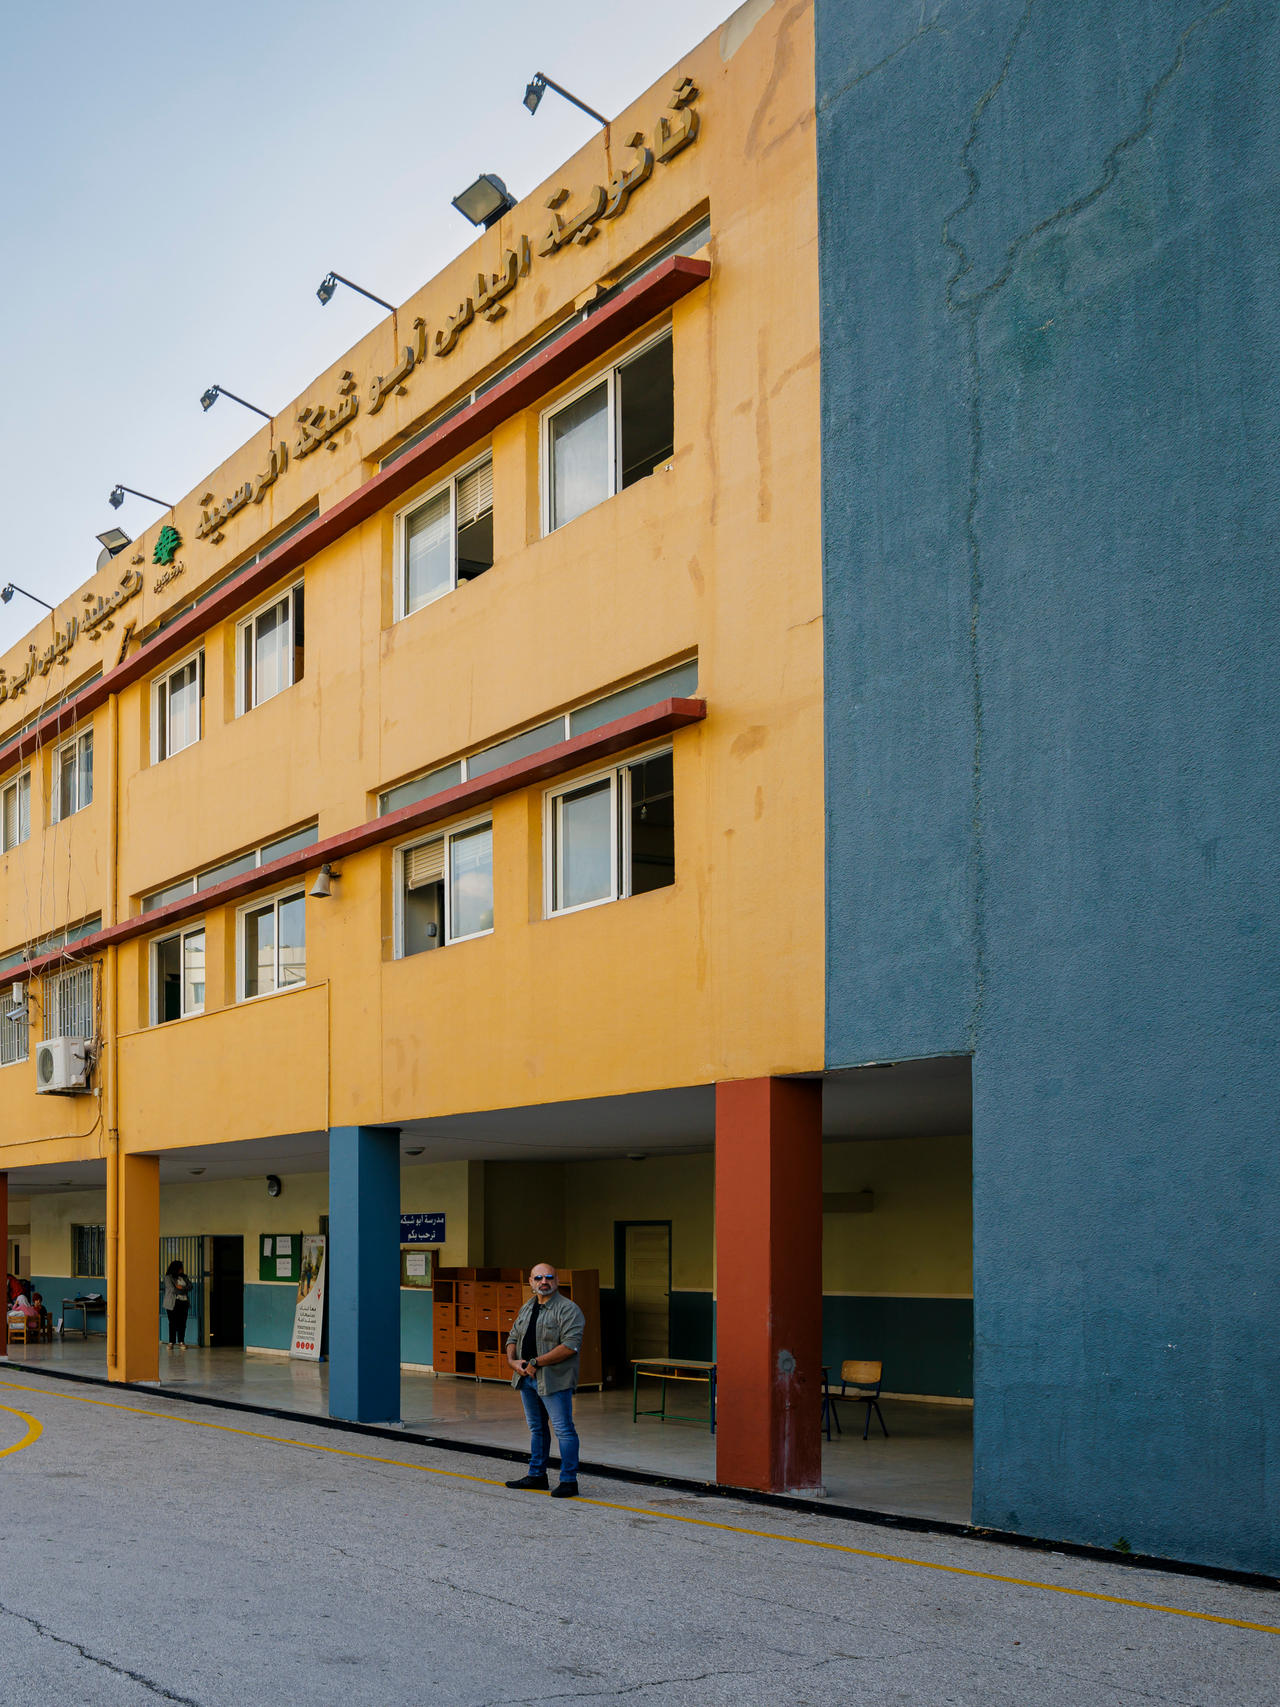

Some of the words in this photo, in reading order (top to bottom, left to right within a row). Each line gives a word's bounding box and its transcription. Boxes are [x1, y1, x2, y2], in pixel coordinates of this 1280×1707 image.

[539, 77, 700, 257] ثانوية
[195, 440, 288, 545] الرسمية
[80, 554, 145, 641] تكميلية
[415, 1213, 424, 1227] أبو
[424, 1214, 444, 1226] مدرسة
[407, 1229, 418, 1242] بكم
[418, 1230, 436, 1241] ترحب
